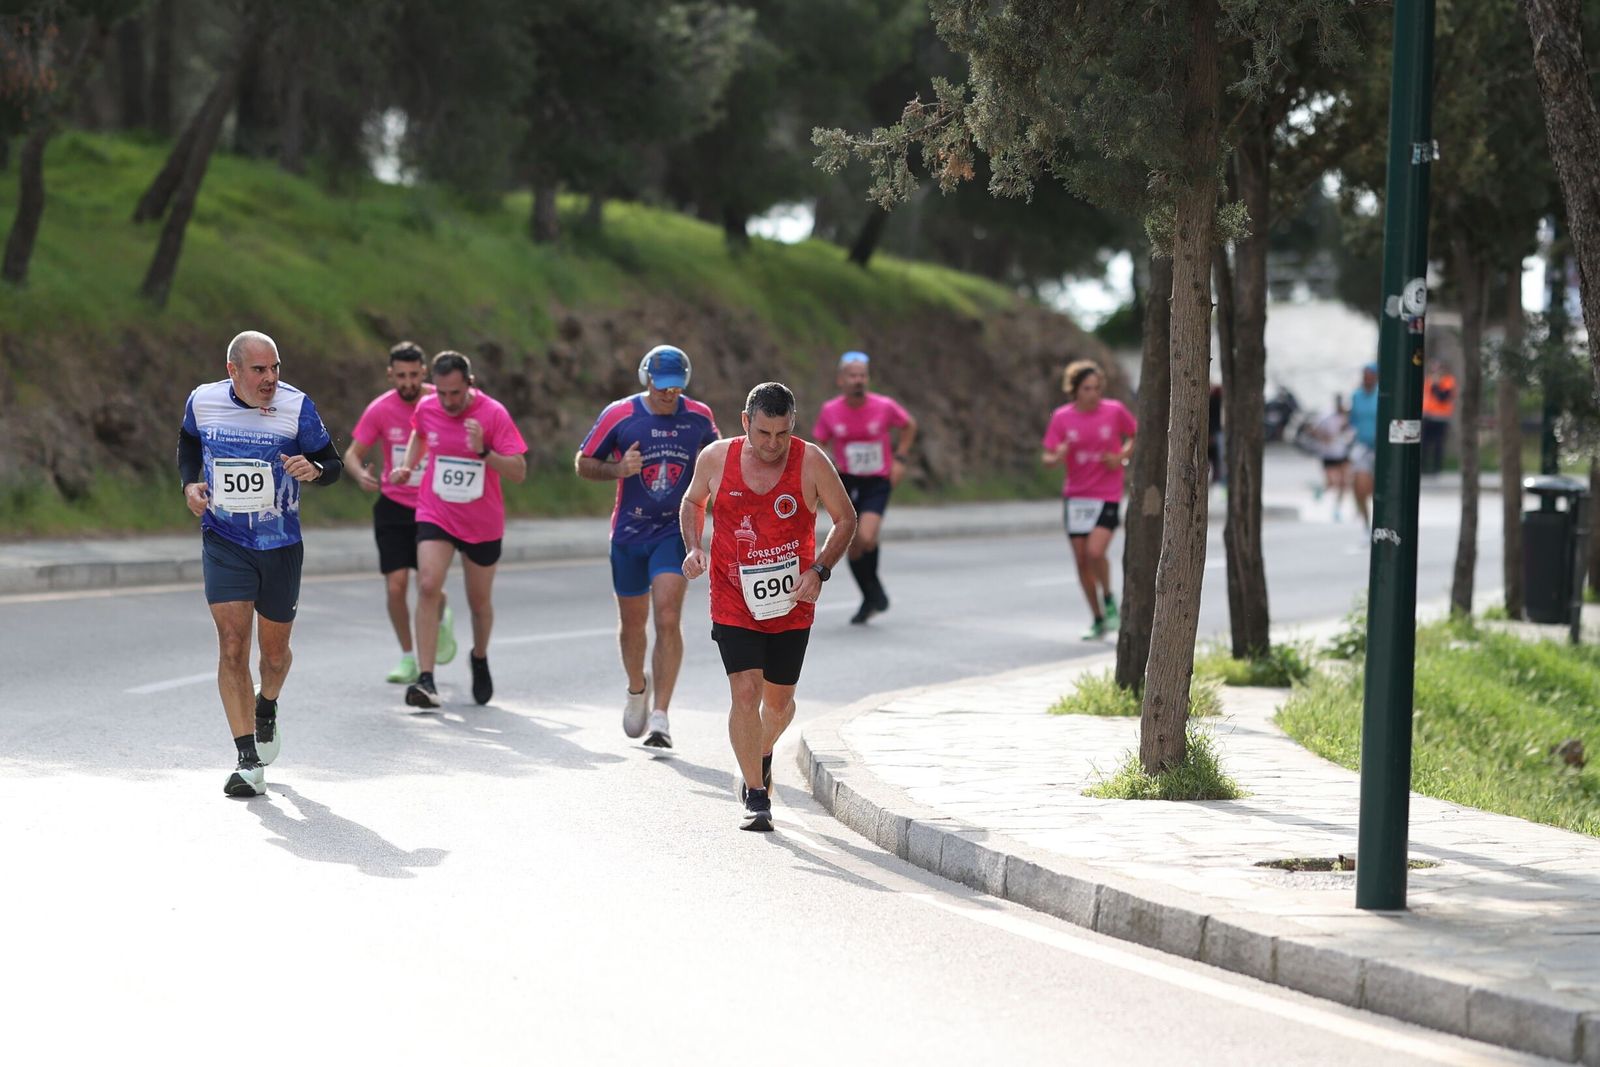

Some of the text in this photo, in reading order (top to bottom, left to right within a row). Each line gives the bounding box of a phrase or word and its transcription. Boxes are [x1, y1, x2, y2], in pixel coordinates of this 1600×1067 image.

[206, 427, 217, 440] 31
[219, 427, 274, 440] TotalEnergies
[223, 472, 265, 493] 509
[442, 468, 476, 488] 697
[747, 539, 801, 559] CORREDORES
[757, 550, 797, 566] CON MIGA
[753, 574, 795, 600] 690
